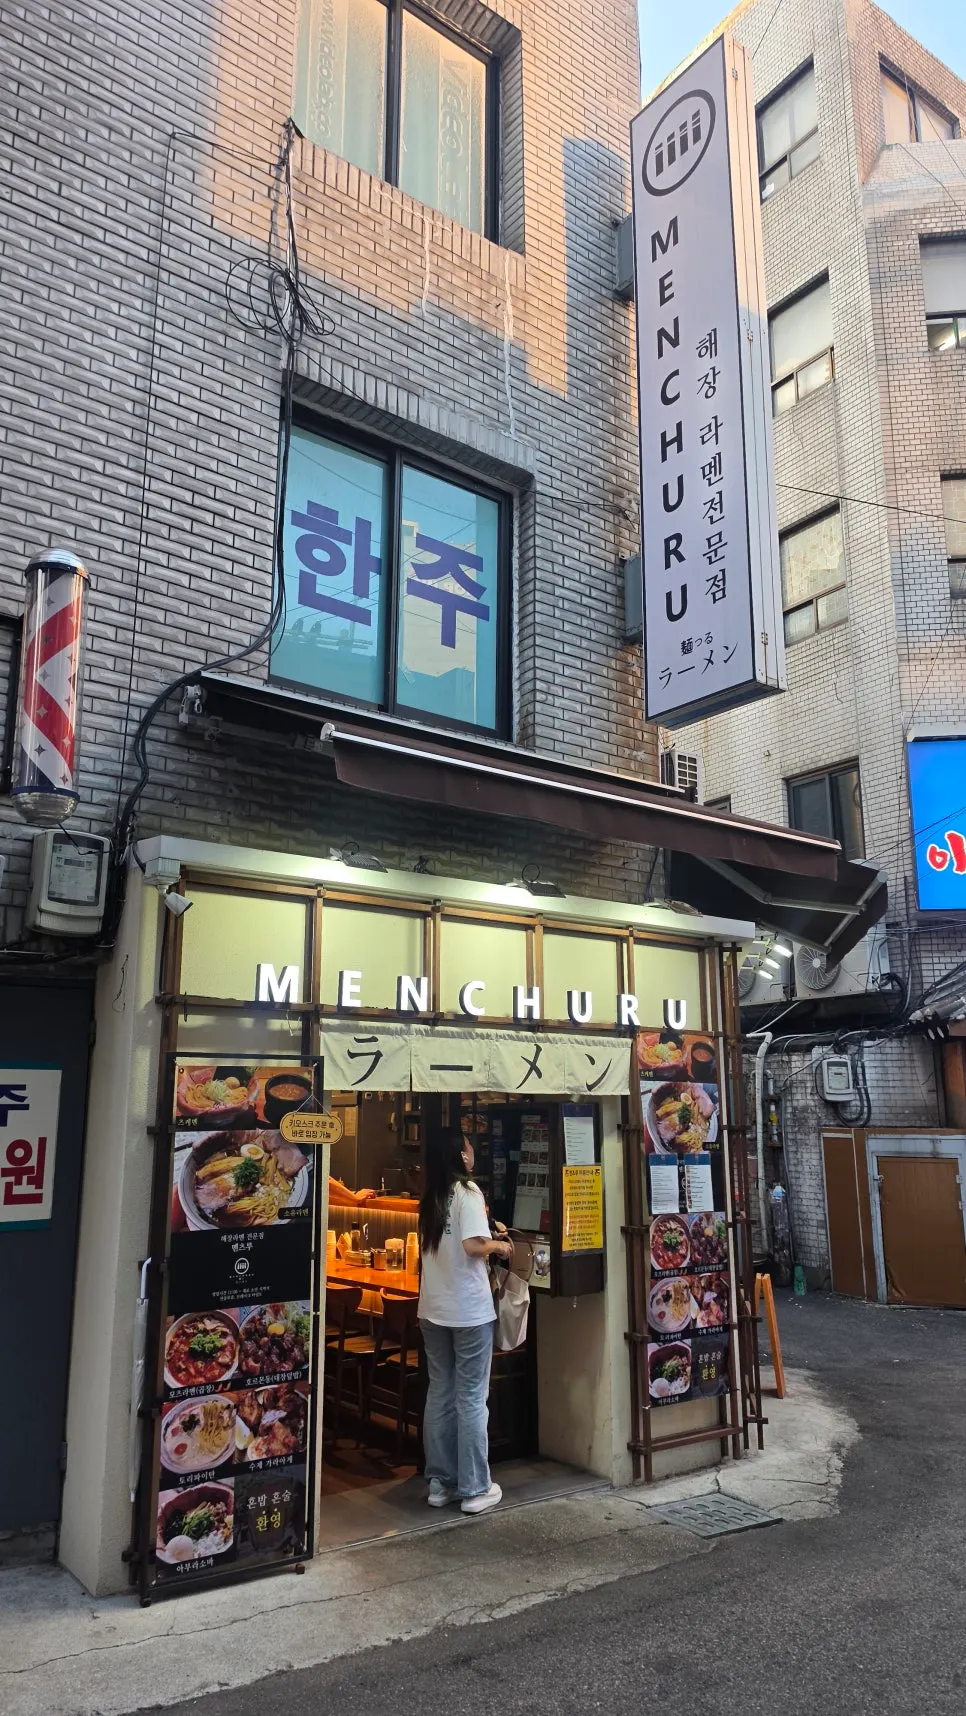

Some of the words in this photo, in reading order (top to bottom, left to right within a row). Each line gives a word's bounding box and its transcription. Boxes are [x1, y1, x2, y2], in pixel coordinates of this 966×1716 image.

[650, 214, 689, 623] MENCHURU
[658, 641, 739, 690] ラーメン
[256, 963, 687, 1030] MENCHURU
[347, 1035, 613, 1092] ラーメン
[289, 1119, 314, 1128] 키오스크
[291, 1130, 304, 1138] 바로
[306, 1130, 318, 1139] 입장
[1, 1137, 47, 1206] 원
[246, 1493, 268, 1510] 혼밥
[271, 1489, 292, 1504] 혼술
[256, 1511, 281, 1532] 환영
